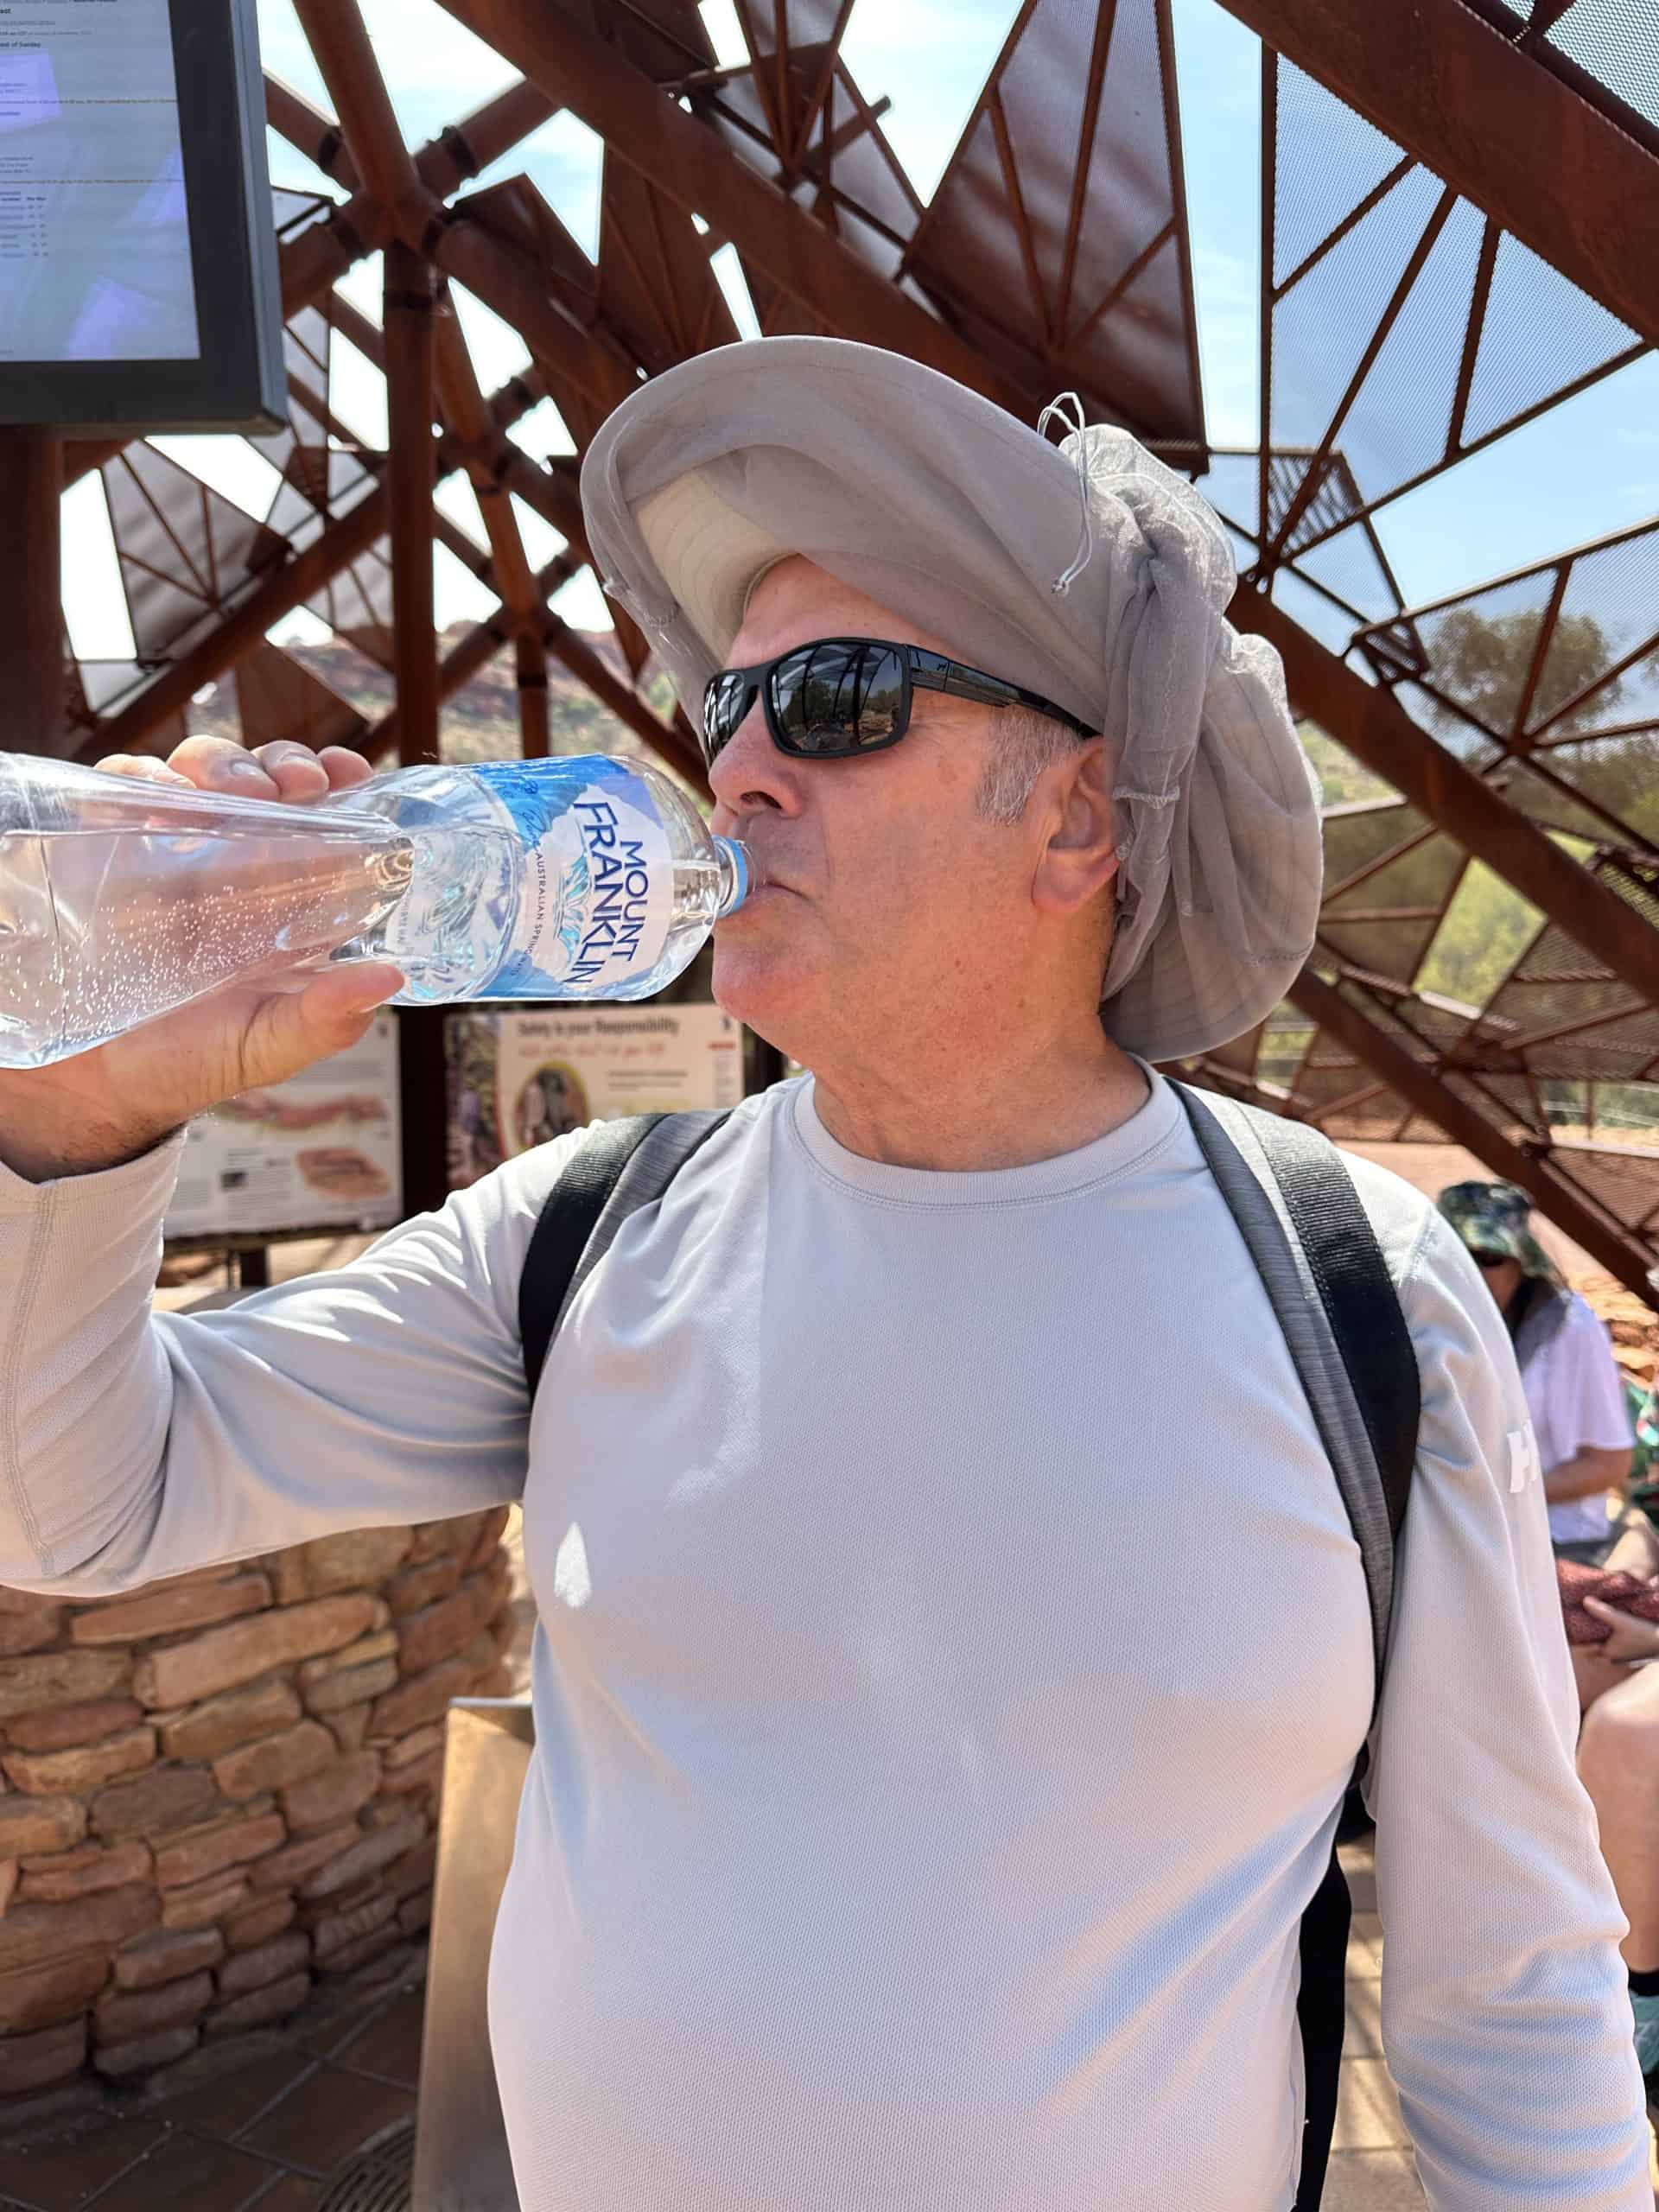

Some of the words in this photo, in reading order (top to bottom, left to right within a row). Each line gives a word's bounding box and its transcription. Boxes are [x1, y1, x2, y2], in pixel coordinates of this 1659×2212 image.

[534, 852, 547, 920] AUSTRALIAN
[563, 801, 624, 984] FRANKLIN
[612, 840, 649, 962] MOUNT
[524, 924, 543, 955] SPRING
